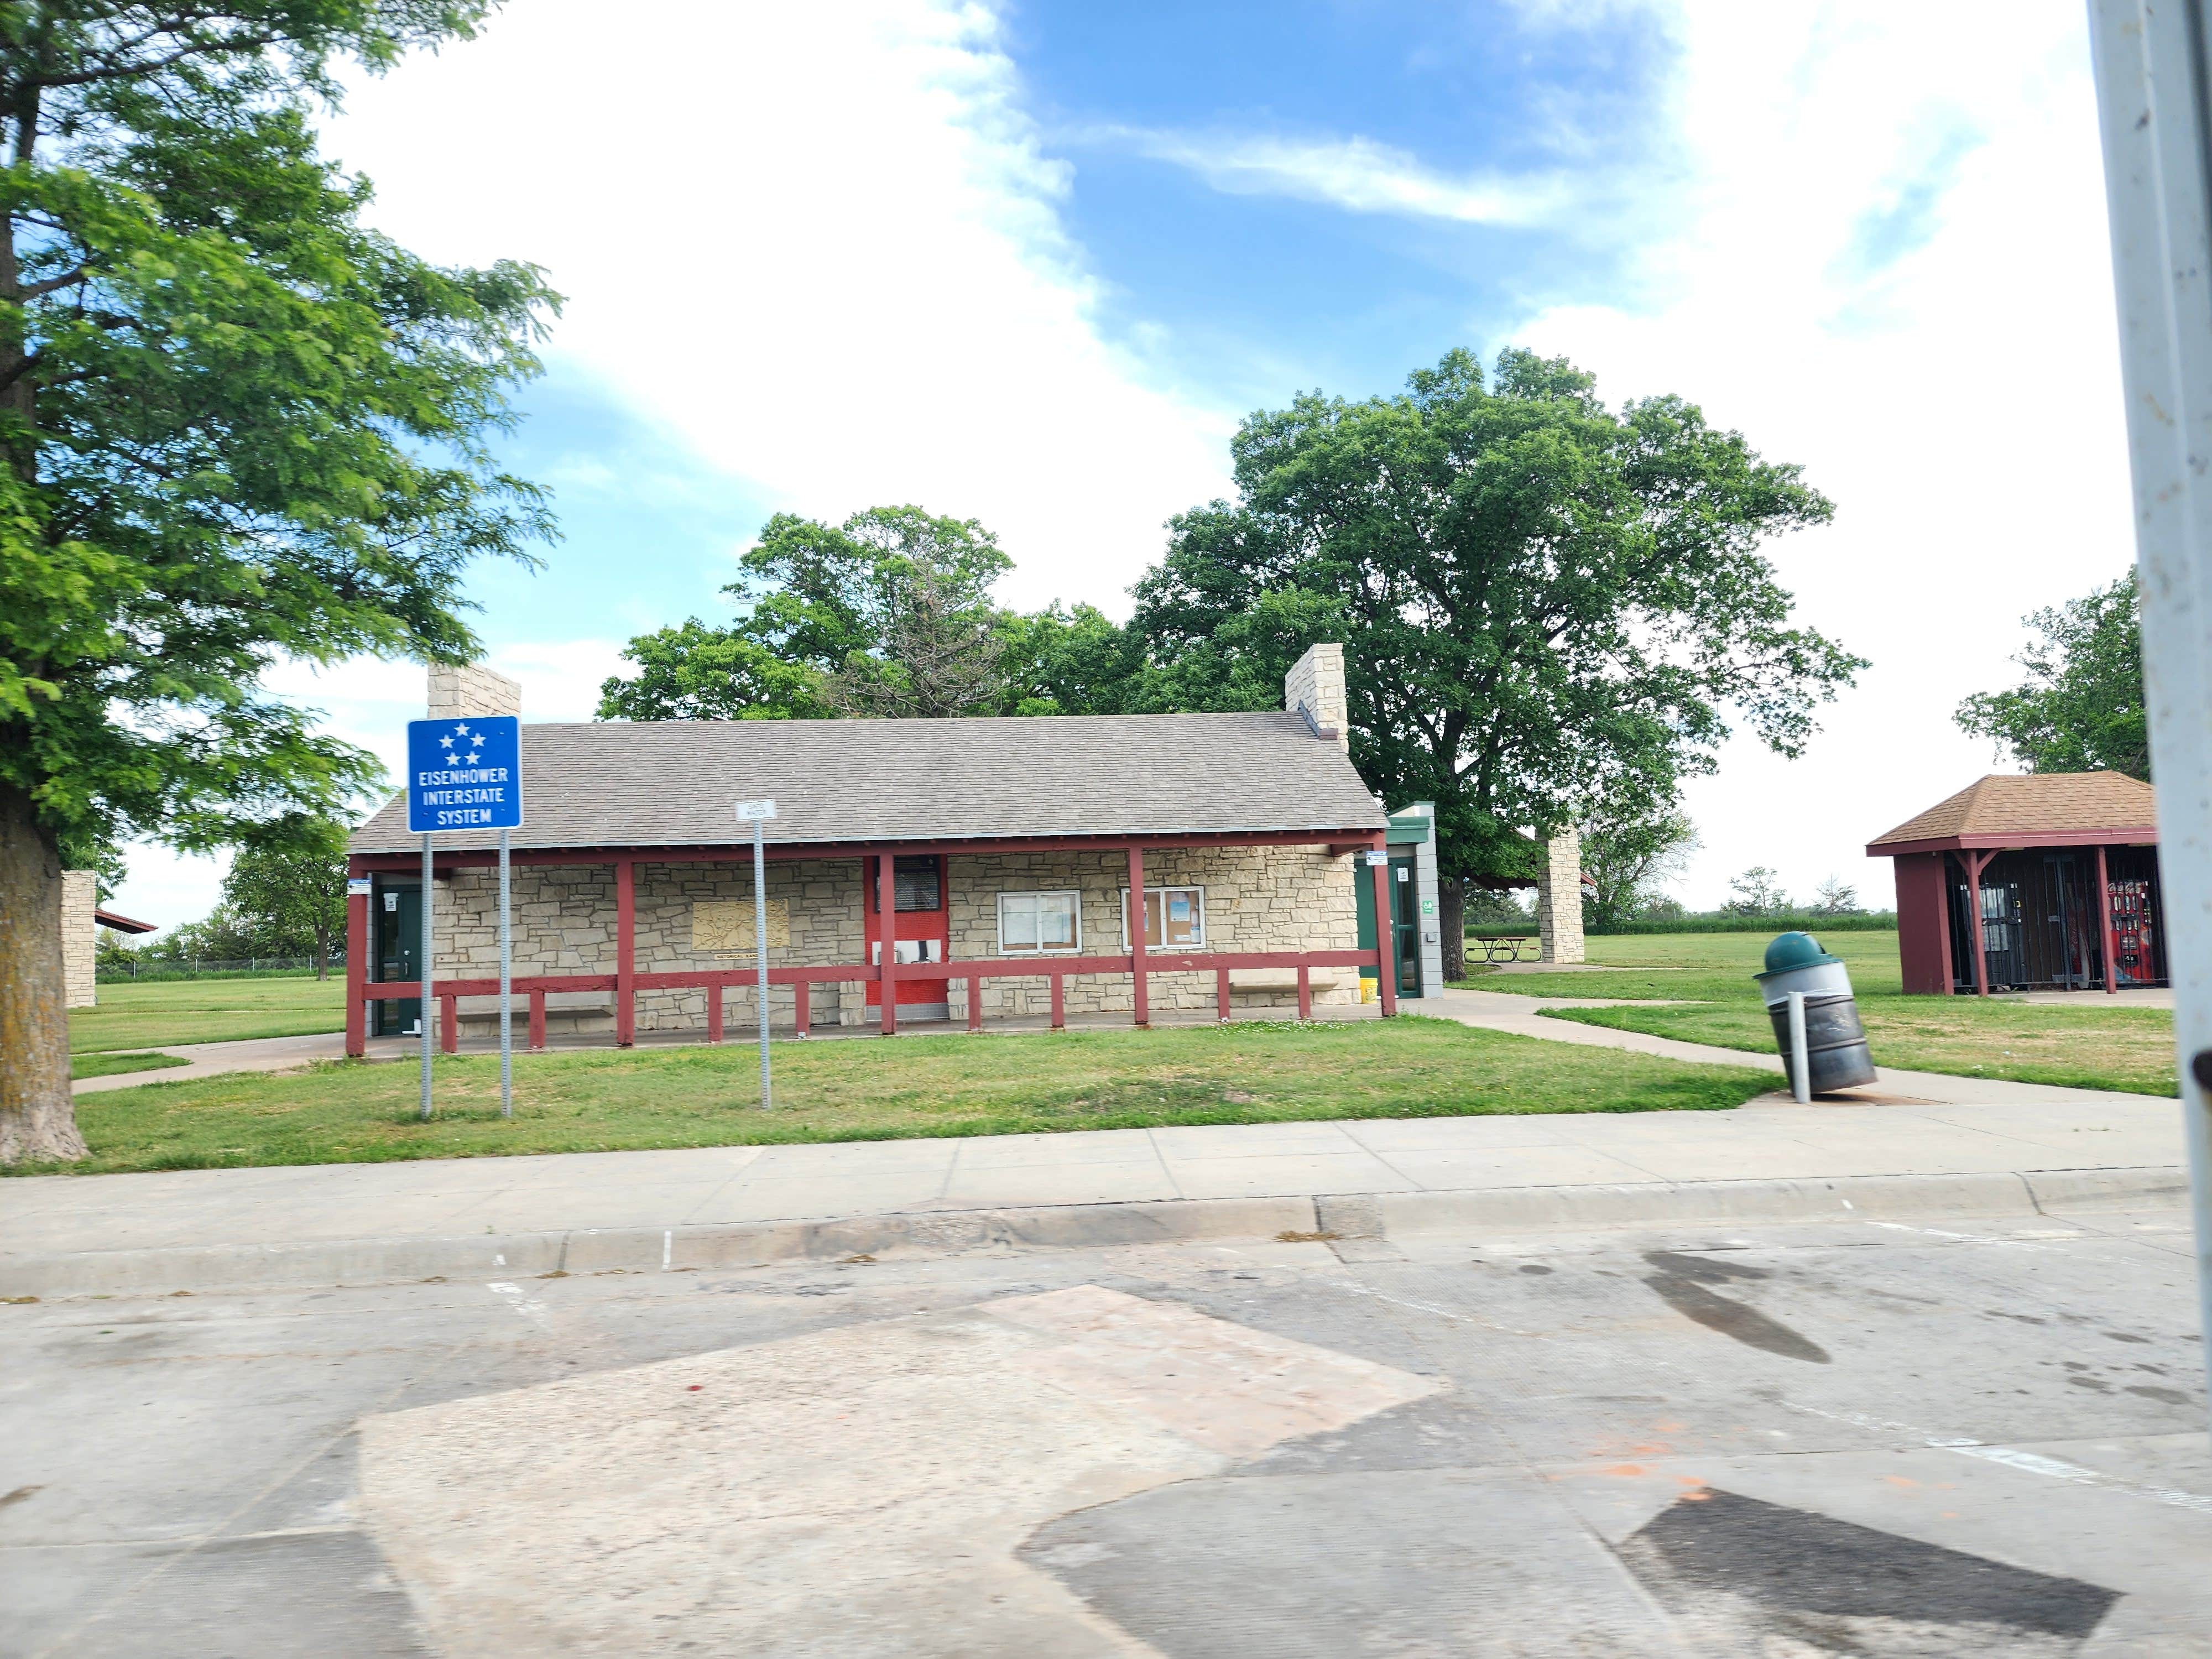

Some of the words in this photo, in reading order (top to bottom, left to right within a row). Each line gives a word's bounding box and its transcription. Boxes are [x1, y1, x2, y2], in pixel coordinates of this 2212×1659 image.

[419, 768, 508, 786] EISENHOWER
[423, 788, 505, 806] INTERSTATE
[437, 808, 492, 825] SYSTEM
